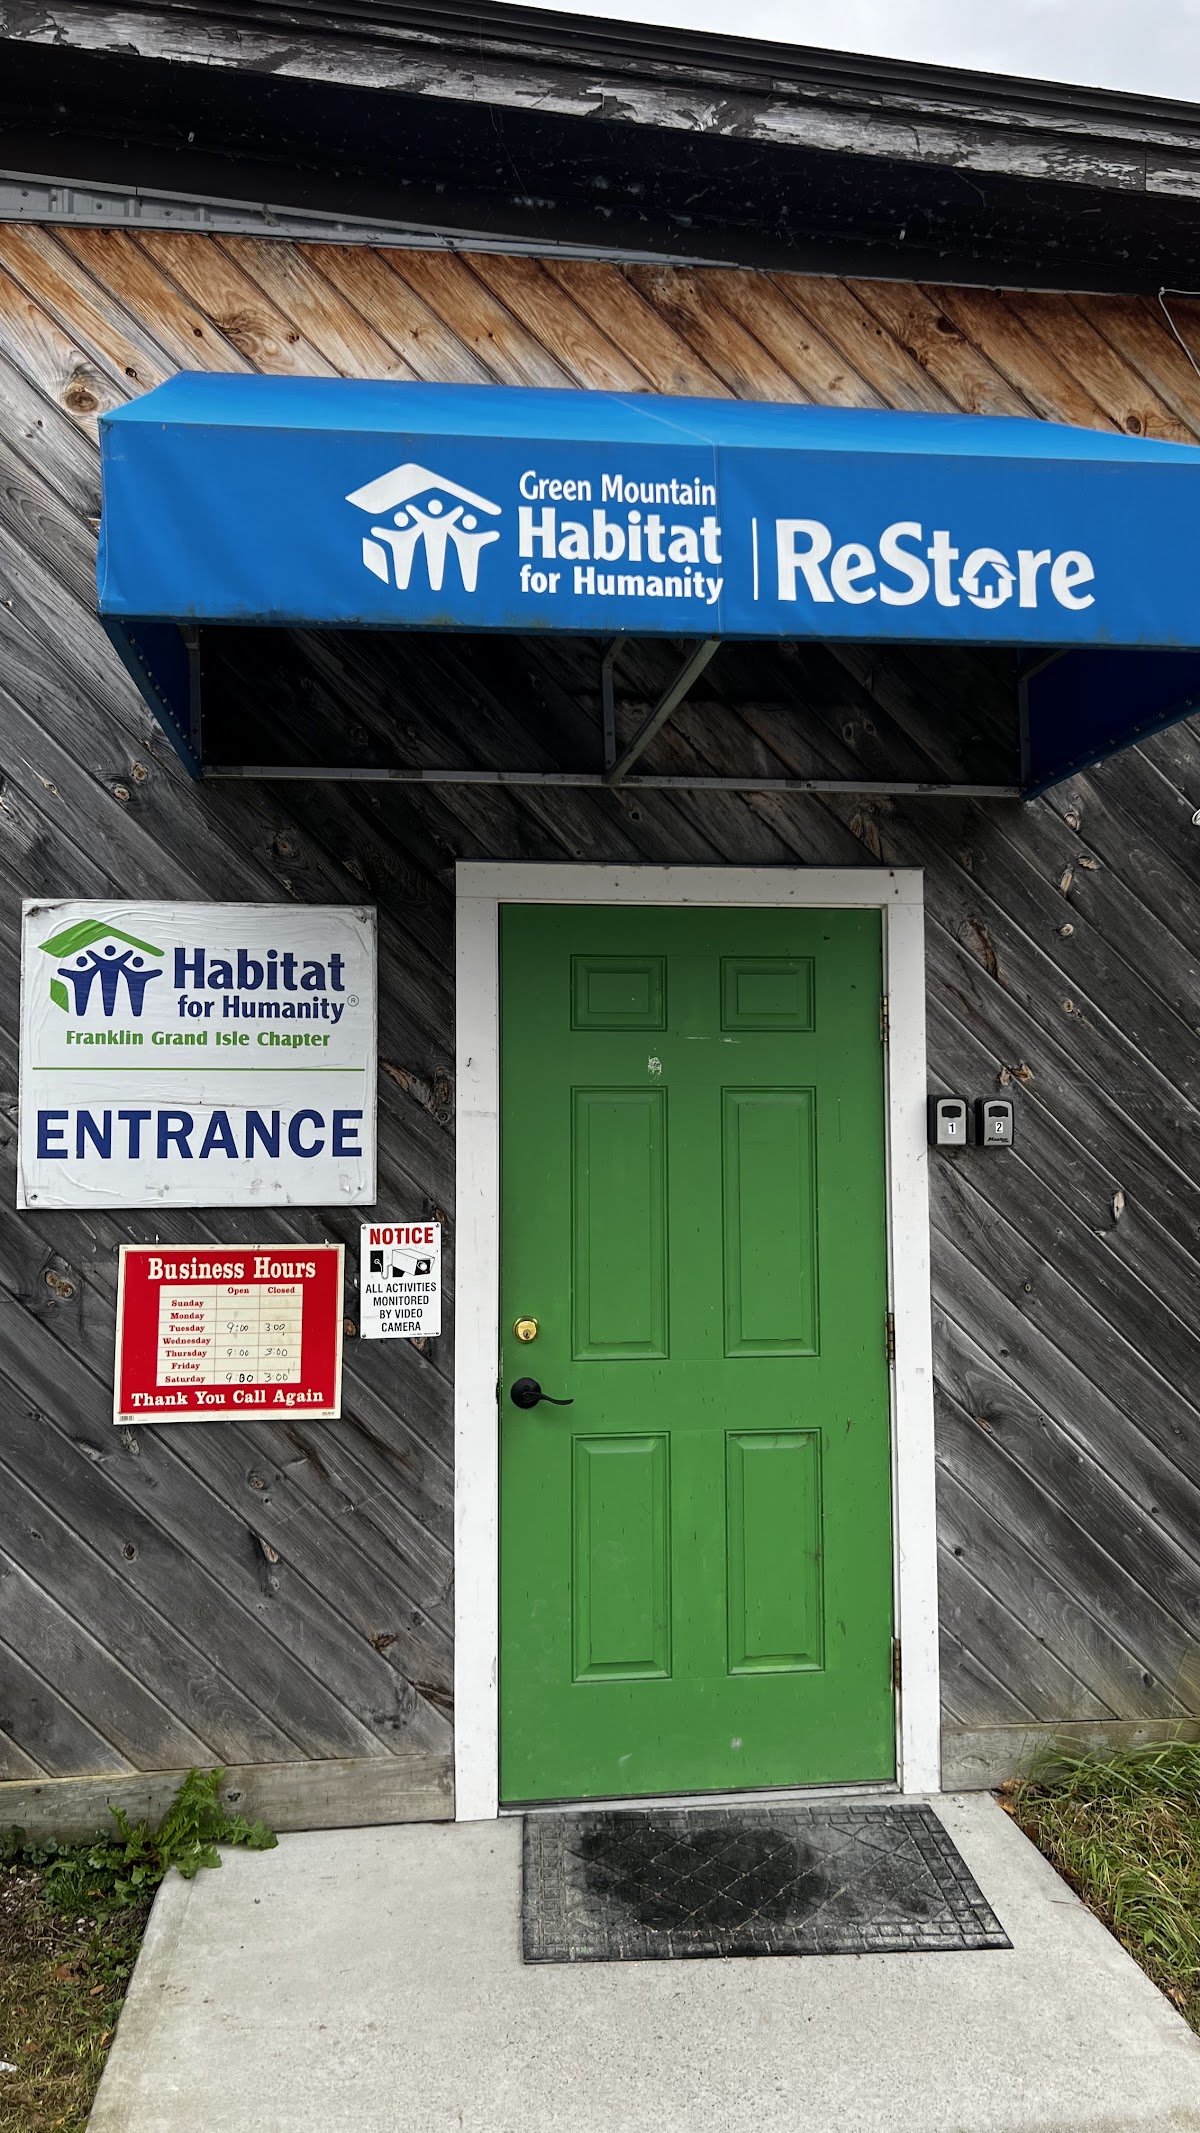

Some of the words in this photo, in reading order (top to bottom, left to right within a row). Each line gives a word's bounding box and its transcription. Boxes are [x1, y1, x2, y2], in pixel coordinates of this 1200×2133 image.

[519, 470, 592, 501] Green
[601, 473, 716, 506] Mountain
[518, 505, 723, 565] Habitat
[775, 518, 1096, 611] ReStore
[519, 563, 561, 594] for
[573, 565, 724, 605] Humanity
[173, 946, 346, 992] Habitat
[177, 994, 216, 1019] for
[65, 1030, 144, 1046] Franklin
[151, 1030, 208, 1046] Grand
[215, 1030, 250, 1046] Isle
[256, 1031, 331, 1049] Chapter
[949, 1123, 954, 1133] 1
[996, 1122, 1002, 1133] 2
[36, 1109, 364, 1160] ENTRANCE
[369, 1227, 434, 1245] NOTICE
[147, 1257, 245, 1280] Business
[253, 1256, 316, 1279] Hours
[227, 1286, 250, 1296] Open
[267, 1286, 295, 1294] Closed
[365, 1283, 383, 1294] ALL
[386, 1282, 437, 1293] ACTIVITIES
[171, 1299, 204, 1308] Sunday
[373, 1295, 429, 1306] MONITORED
[170, 1312, 205, 1320] Monday
[379, 1309, 392, 1319] BY
[394, 1308, 423, 1319] VIDEO
[168, 1324, 205, 1333] Tuesday
[226, 1322, 249, 1333] 9:00
[265, 1322, 286, 1332] 3:00
[381, 1321, 421, 1332] CAMERA
[162, 1337, 211, 1345] Wednesday
[165, 1349, 207, 1358] Thursday
[226, 1348, 250, 1357] 9:00
[264, 1347, 288, 1357] 3:00
[171, 1362, 201, 1371] Friday
[165, 1374, 206, 1384] Saturday
[264, 1372, 289, 1383] 3:00
[131, 1392, 188, 1407] Thank
[195, 1390, 226, 1405] You
[233, 1389, 266, 1403] Call
[273, 1388, 324, 1406] Again
